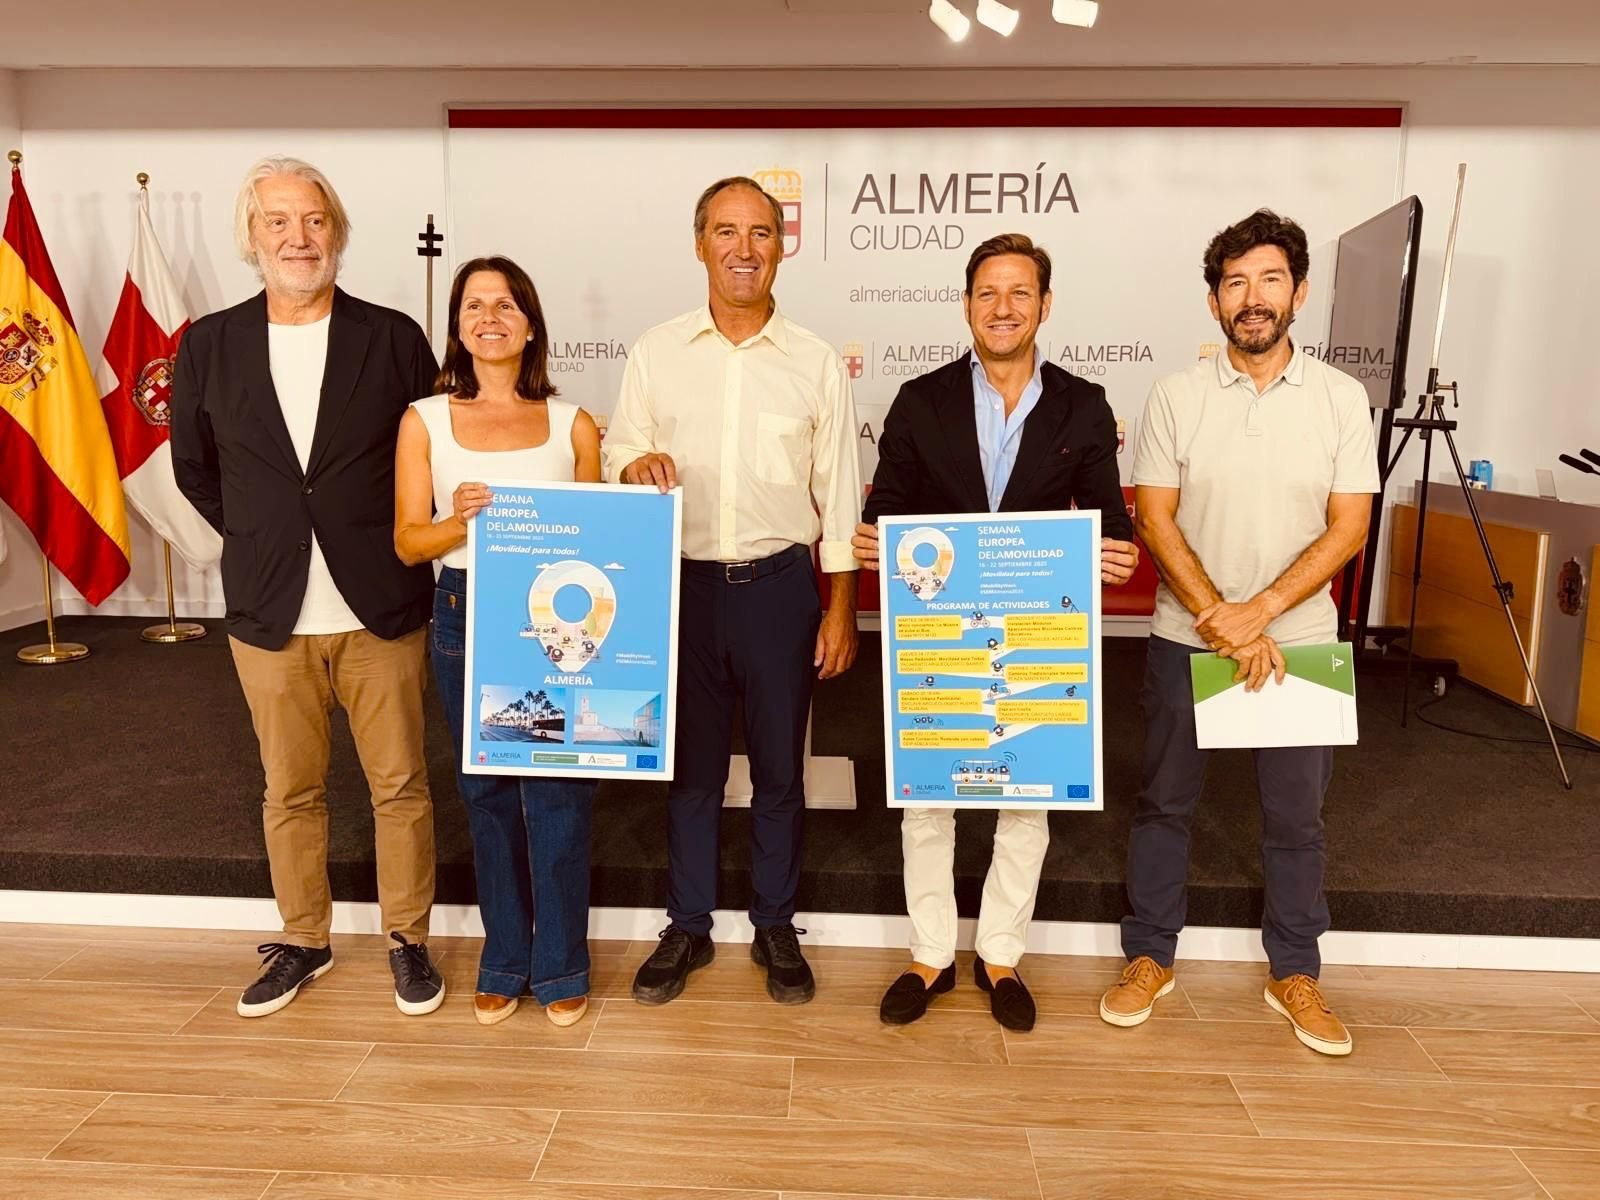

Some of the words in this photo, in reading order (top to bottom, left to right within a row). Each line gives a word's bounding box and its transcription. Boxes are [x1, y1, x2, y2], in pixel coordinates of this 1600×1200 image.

[851, 162, 1080, 215] ALMERÍA
[850, 225, 965, 250] CIUDAD
[1060, 340, 1153, 362] ALMERÍA
[882, 365, 929, 376] CIUDAD
[491, 493, 535, 505] EMANA
[487, 507, 539, 519] EUROPEA
[486, 522, 580, 535] DELAMOVILIDAD
[977, 526, 1021, 535] SEMANA
[978, 537, 1025, 547] EUROPEA
[486, 544, 532, 554] ¡Movilidad
[532, 547, 551, 555] para
[552, 546, 579, 556] todos!
[978, 549, 1064, 560] DELAMOVILIDAD
[926, 602, 976, 610] PROGRAMA
[978, 601, 990, 609] DE
[992, 600, 1050, 609] ACTIVIDADES
[543, 674, 594, 686] ALMERÍA
